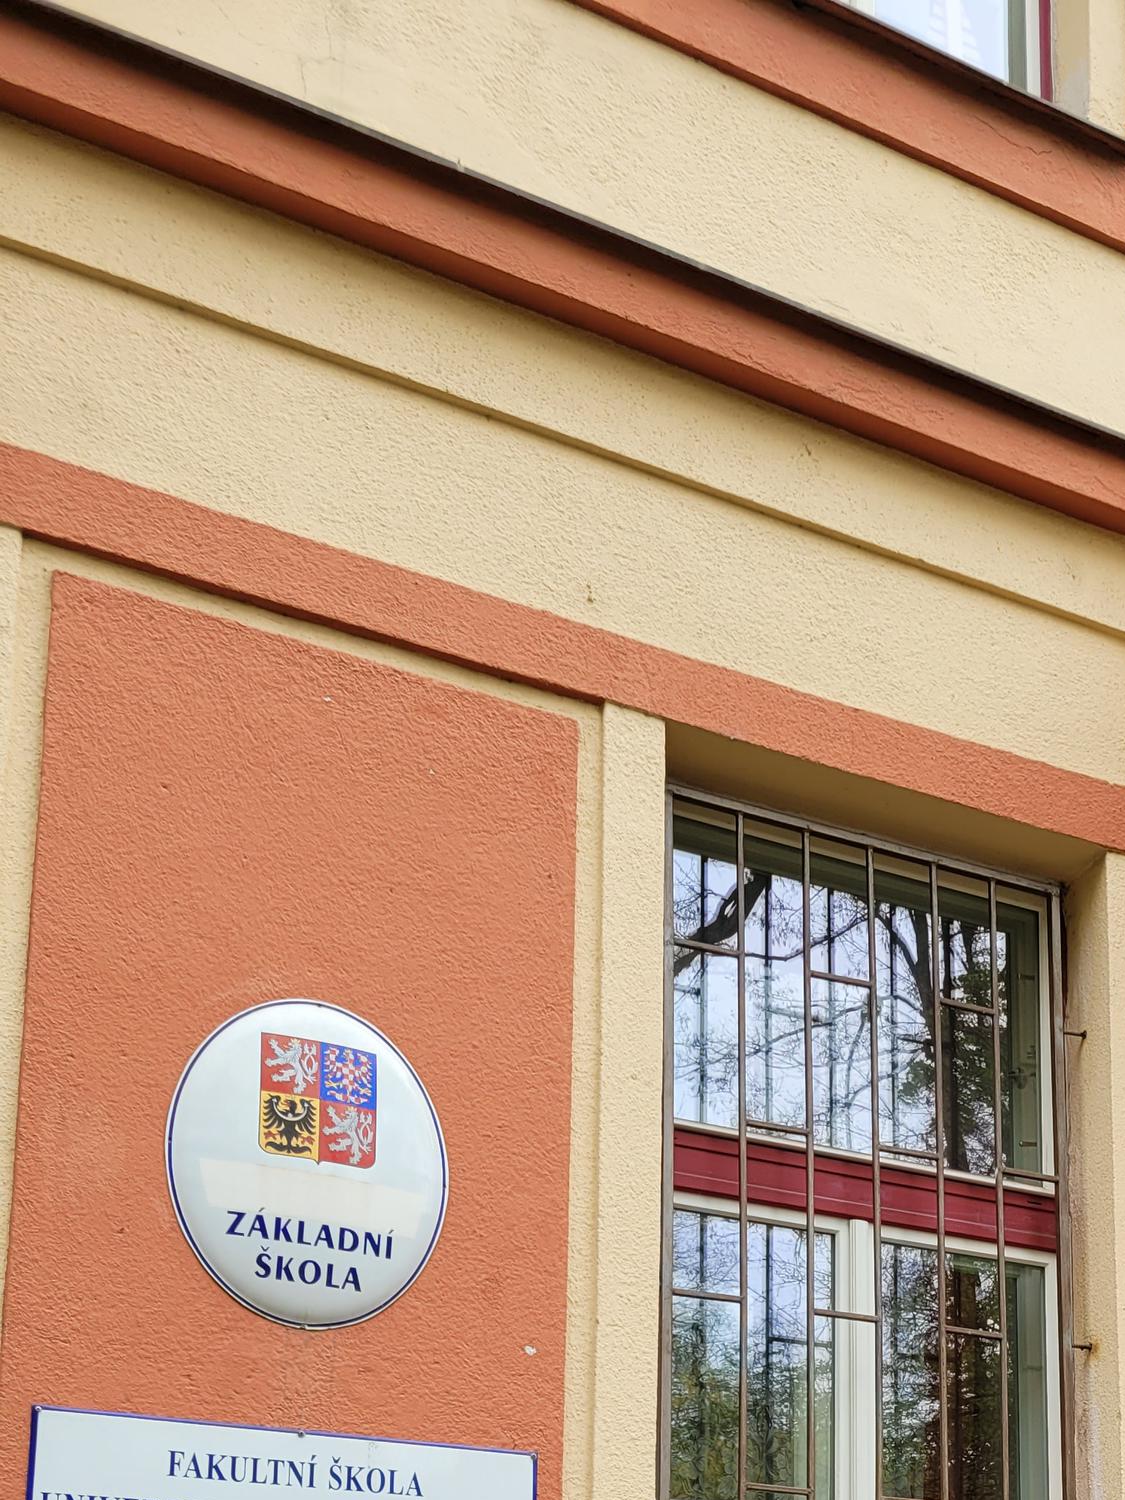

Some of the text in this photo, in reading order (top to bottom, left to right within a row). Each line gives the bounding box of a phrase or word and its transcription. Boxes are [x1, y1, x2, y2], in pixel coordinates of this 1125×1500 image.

[225, 1207, 394, 1260] ZÁKLADNÍ
[254, 1245, 362, 1293] ŠKOLA
[167, 1450, 425, 1497] FAKULTNÍ ŠKOLA
